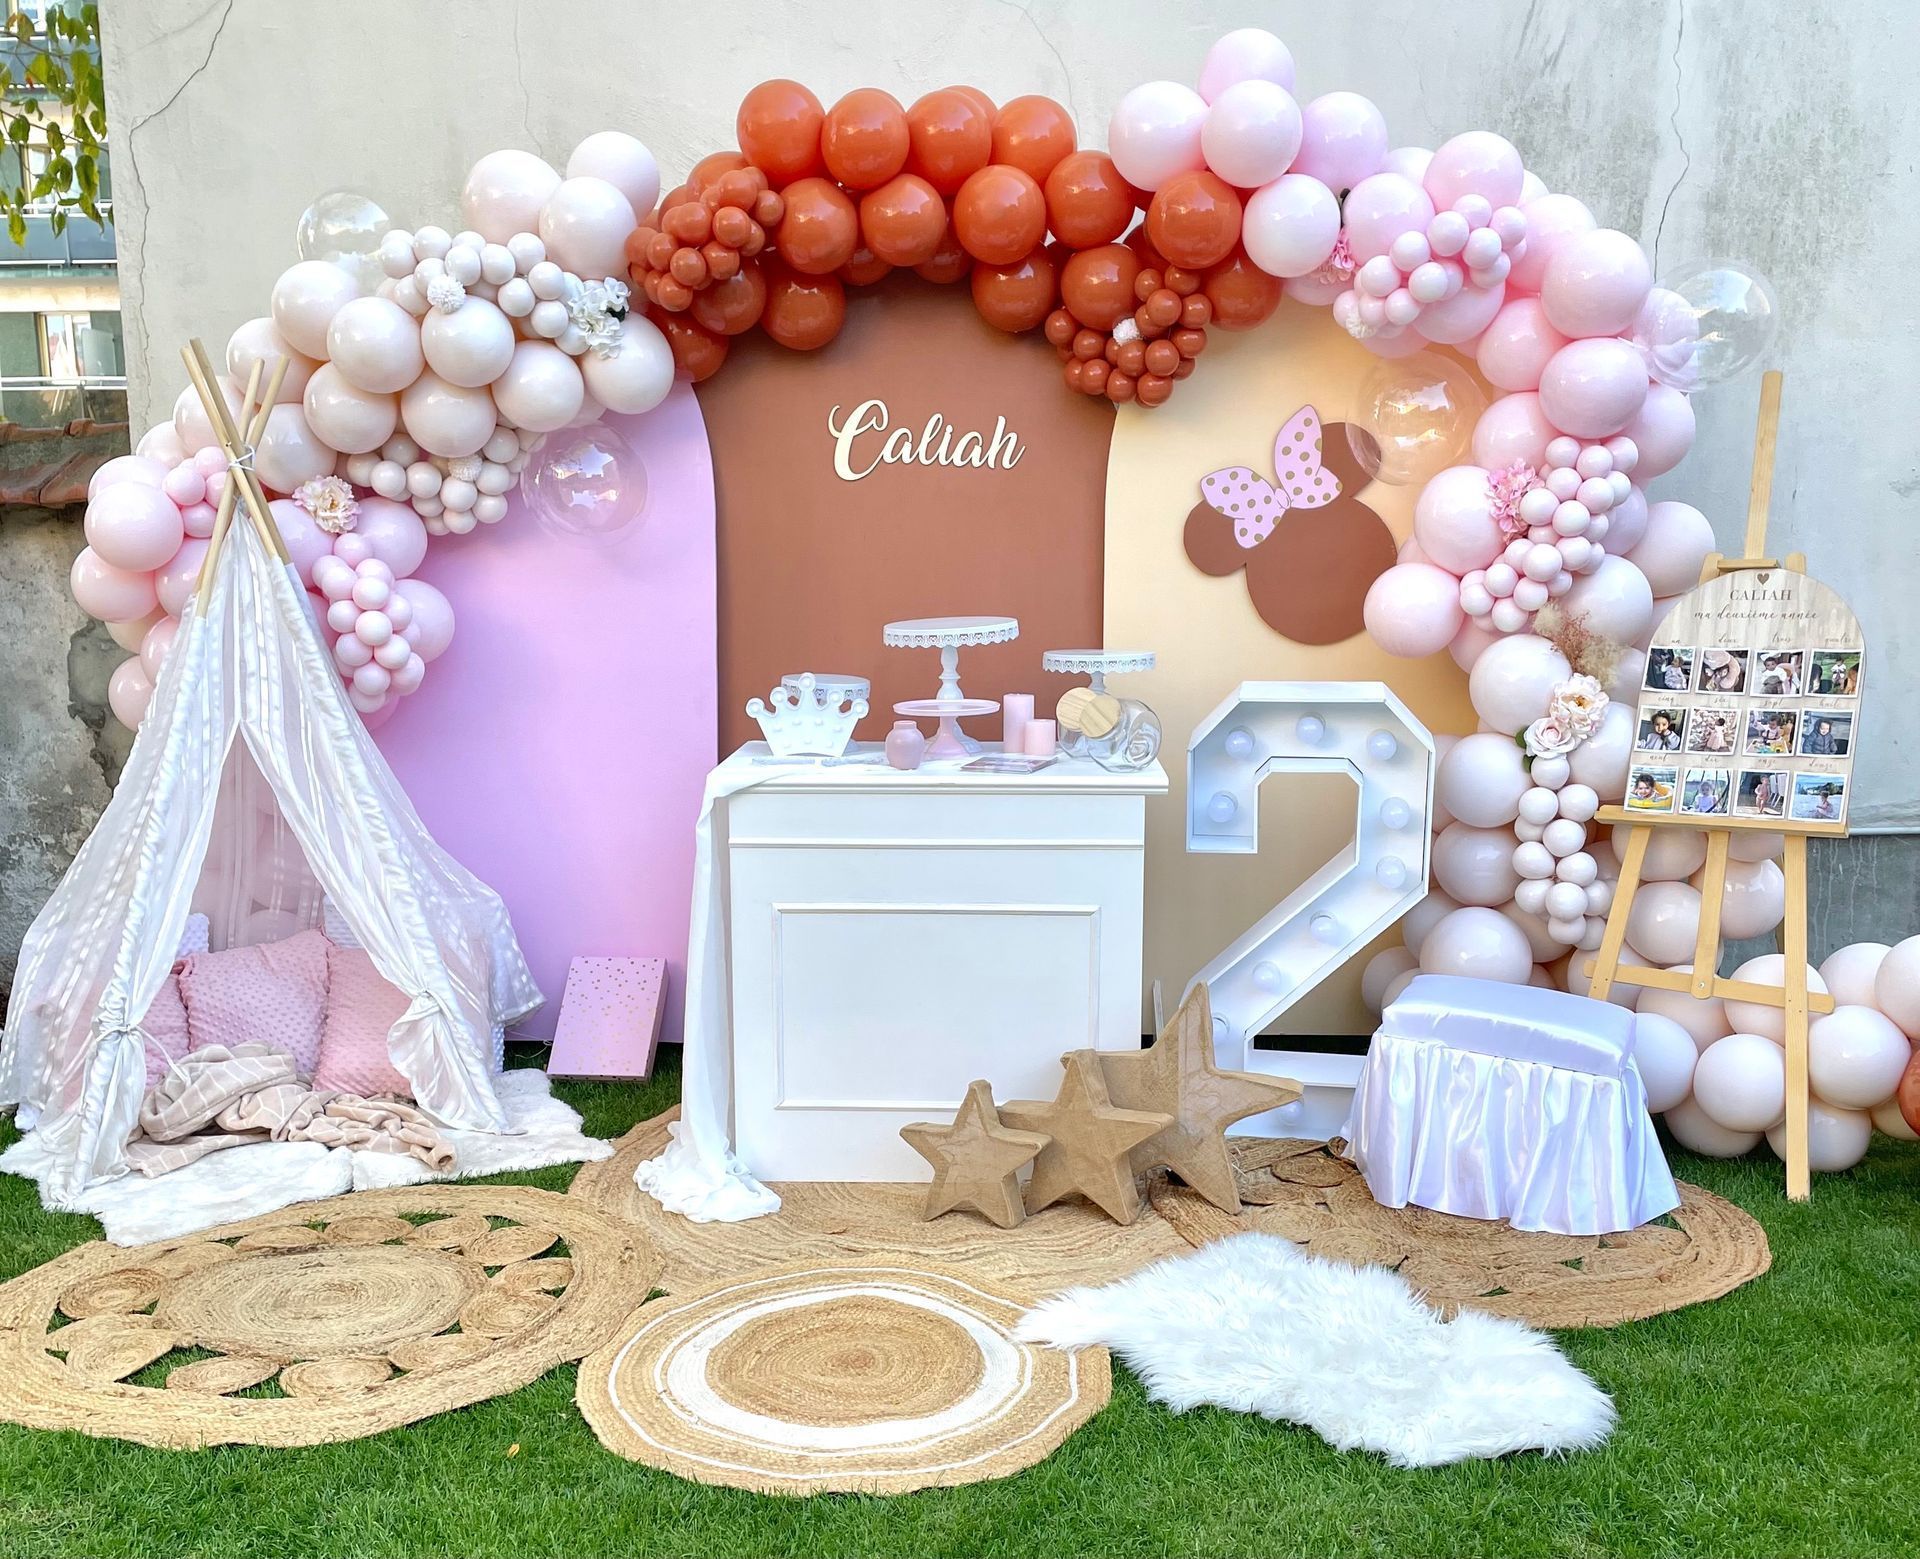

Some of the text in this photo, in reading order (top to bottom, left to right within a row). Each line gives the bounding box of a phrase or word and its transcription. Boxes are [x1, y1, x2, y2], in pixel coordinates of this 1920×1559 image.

[828, 399, 1026, 481] Caliah
[1694, 610, 1712, 620] ma
[1730, 589, 1792, 601] CALIAH
[1186, 681, 1436, 1139] 2
